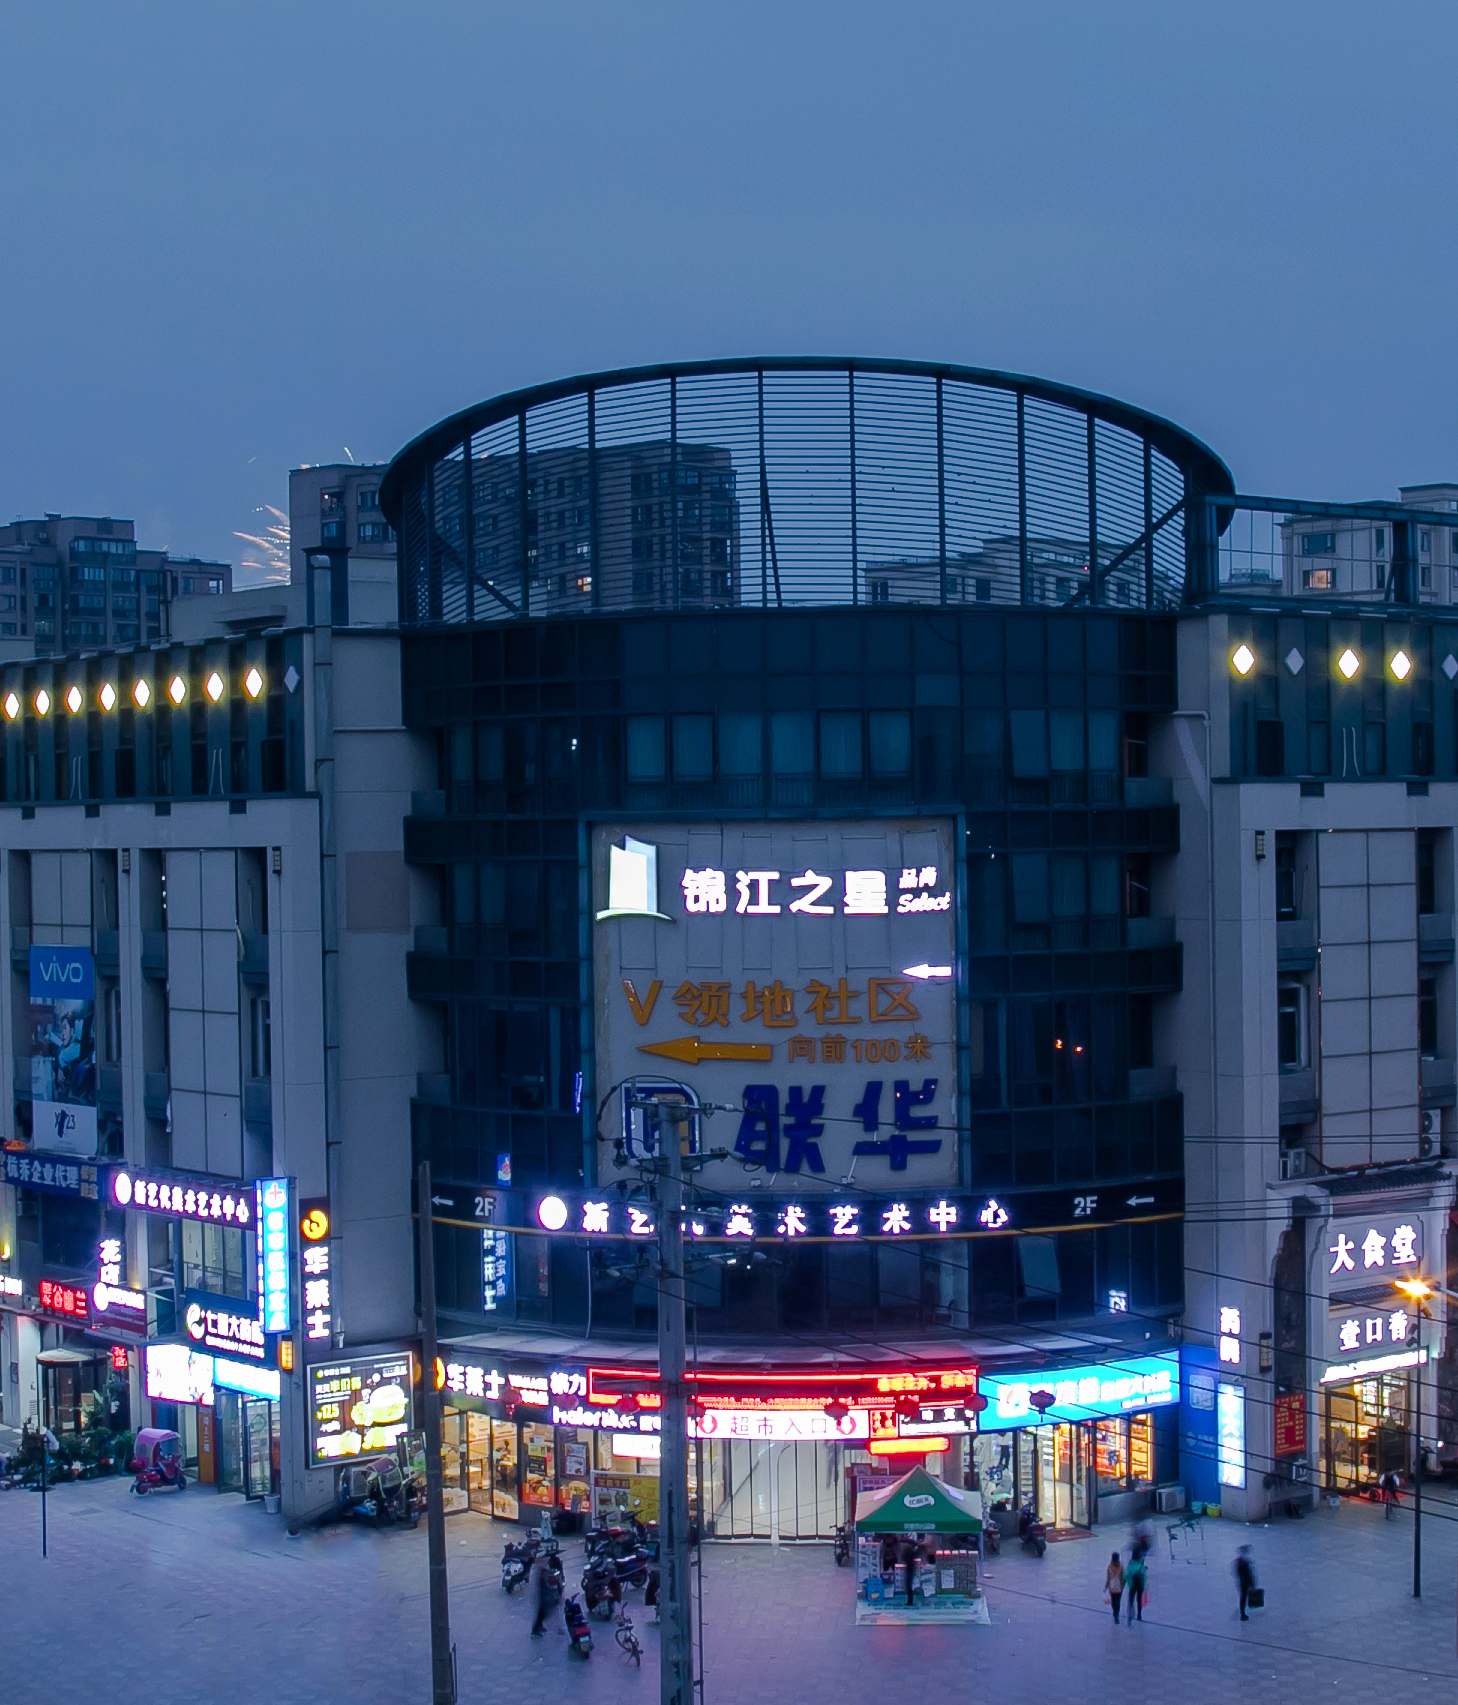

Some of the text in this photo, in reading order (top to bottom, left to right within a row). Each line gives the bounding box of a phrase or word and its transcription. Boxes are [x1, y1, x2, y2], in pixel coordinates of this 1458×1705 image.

[681, 867, 889, 915] 锦江之星
[898, 866, 937, 889] 品尚
[896, 891, 951, 914] Select
[40, 956, 84, 984] vivo
[622, 978, 921, 1028] V领地社区
[788, 1033, 933, 1064] 向前100米
[733, 1078, 942, 1174] 联华
[474, 1196, 495, 1217] 2F
[581, 1199, 1010, 1237] 新艺美术艺术中心
[1073, 1195, 1098, 1217] 2F
[99, 1239, 122, 1285] 花店
[1329, 1224, 1417, 1275] 大食堂
[303, 1245, 331, 1340] 华莱士
[446, 1363, 506, 1401] 华莱士
[549, 1371, 588, 1397] 格力
[729, 1415, 827, 1437] 超市入口
